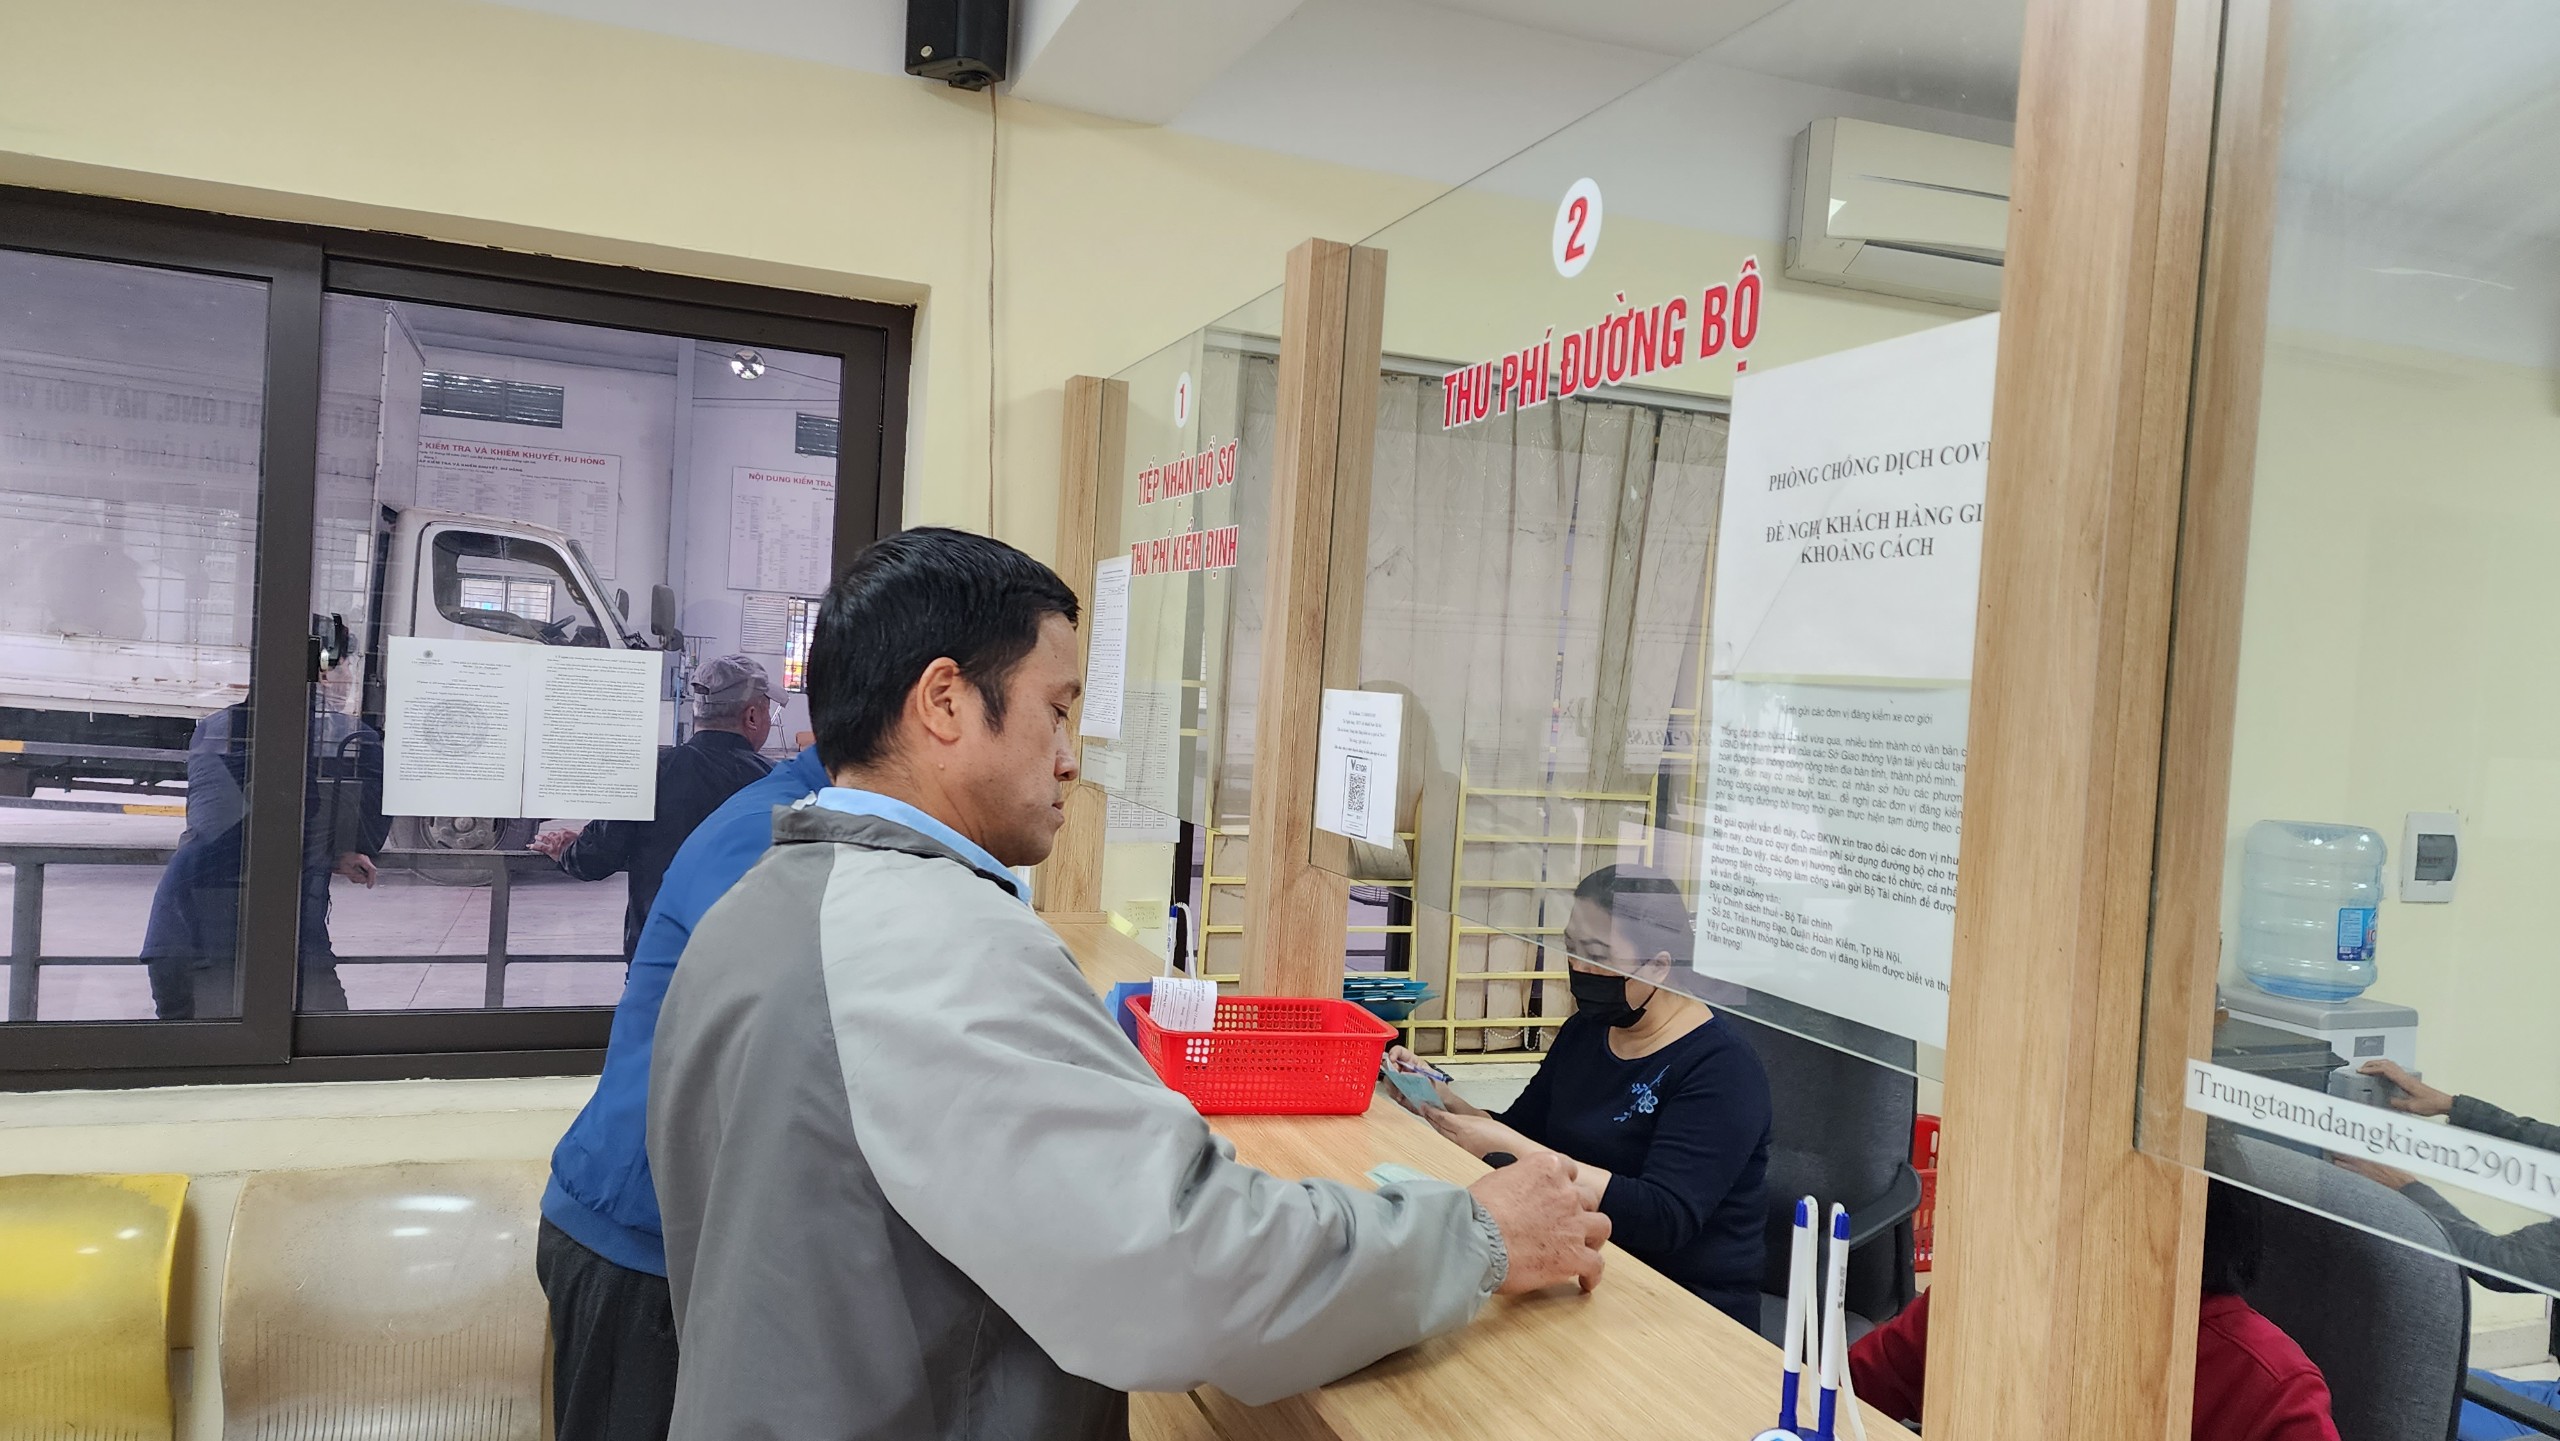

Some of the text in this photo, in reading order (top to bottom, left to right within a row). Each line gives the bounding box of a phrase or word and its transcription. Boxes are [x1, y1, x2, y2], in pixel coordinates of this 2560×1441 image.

[1564, 195, 1589, 263] 2
[1443, 257, 1761, 428] THU PHÍ ĐƯỜNG BỘ
[1179, 383, 1186, 419] 1
[425, 440, 449, 450] KIỂM
[452, 445, 471, 453] TRA
[474, 445, 487, 454] VÀ
[1138, 436, 1238, 507] TIẾP NHẬN HỒ SƠ
[1768, 441, 1991, 491] PHÒNG CHỐNG DỊCH COVI
[748, 472, 764, 482] NỘI
[766, 475, 791, 483] DUNG
[793, 475, 814, 485] KIỂM
[1131, 517, 1239, 579] THU PHÍ KIỂM ĐỊNH
[1766, 503, 1983, 543] ĐỀ NGHỊ KHÁCH HÀNG GI
[1801, 533, 1934, 564] KHOẢNG CÁCH
[2194, 1068, 2560, 1199] Trungtamdangkiem2901v
